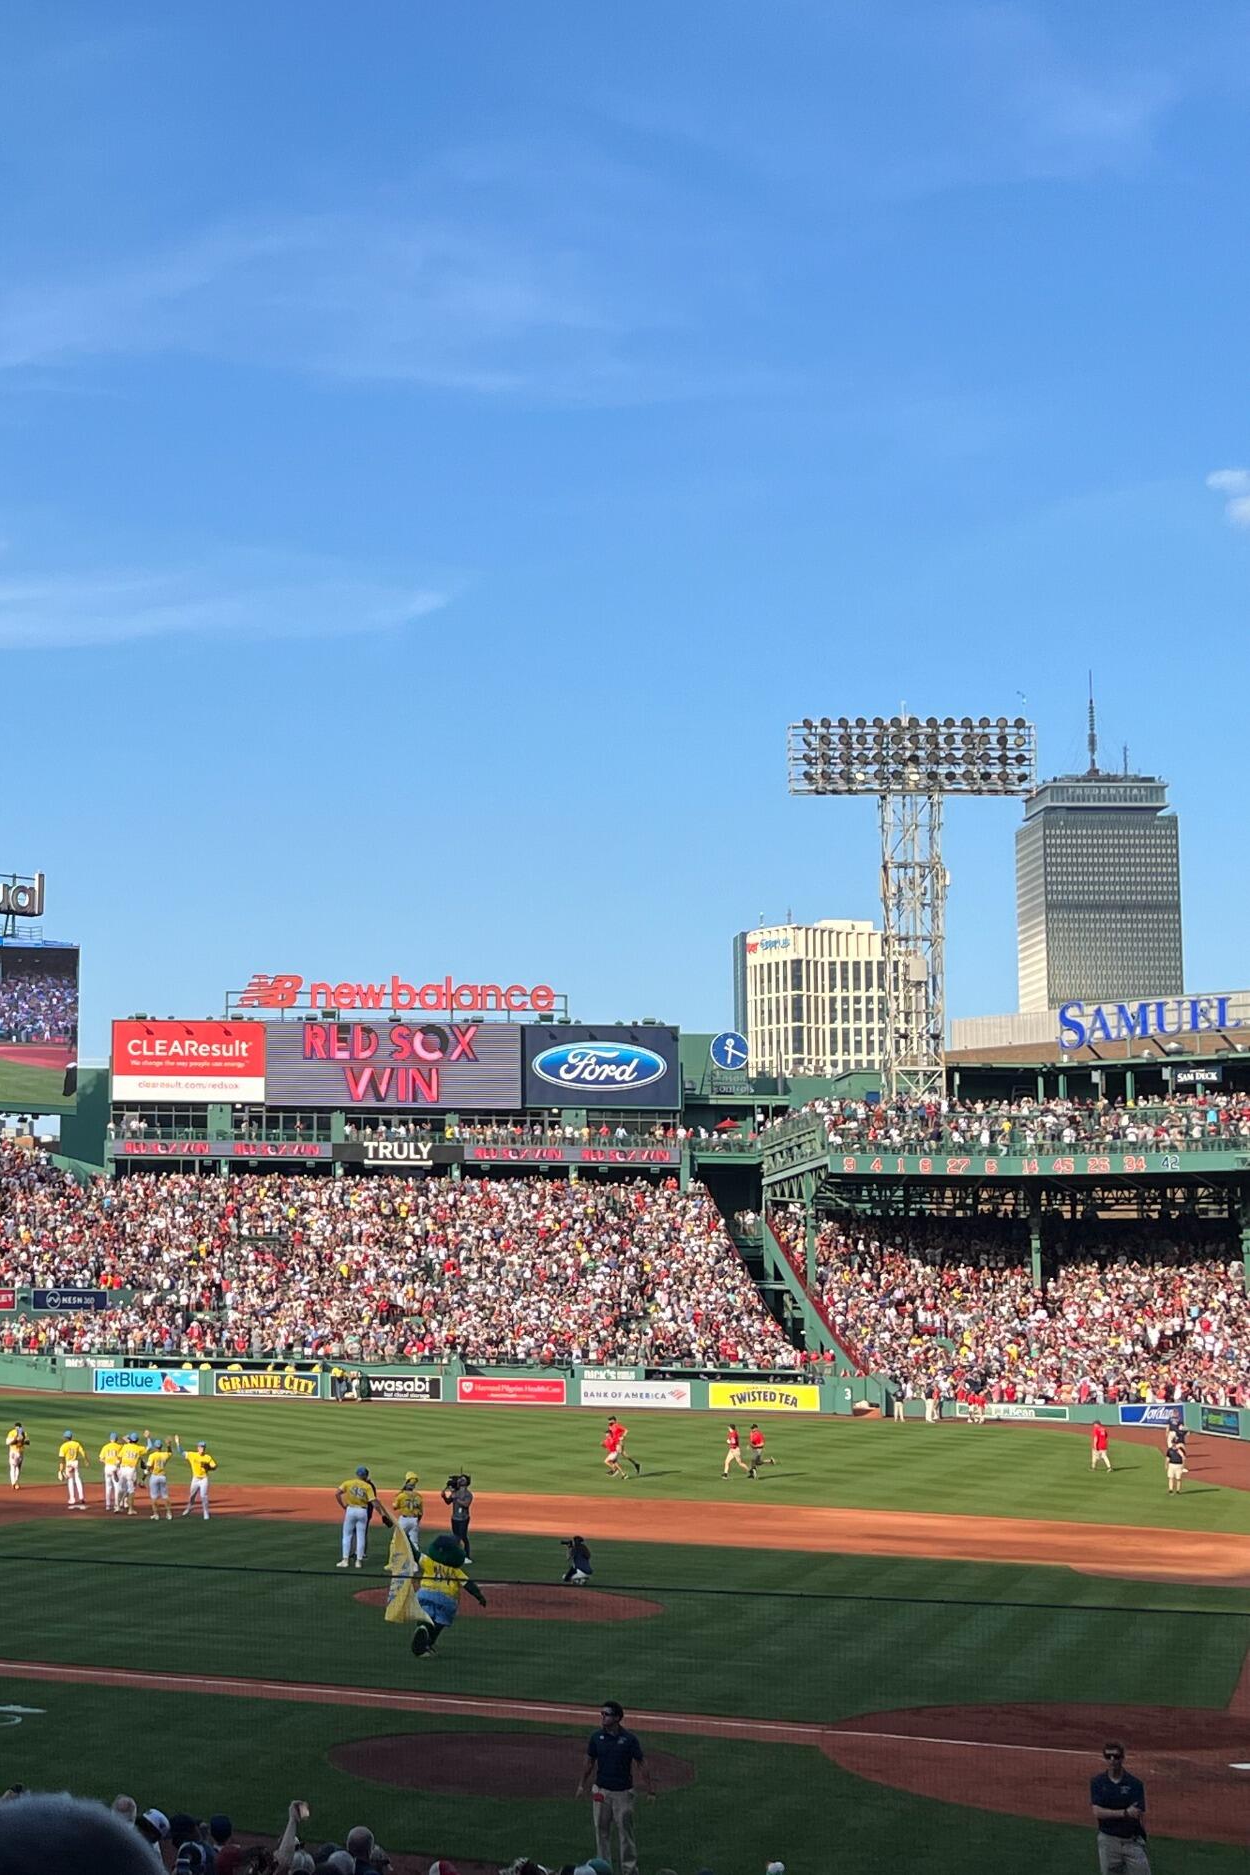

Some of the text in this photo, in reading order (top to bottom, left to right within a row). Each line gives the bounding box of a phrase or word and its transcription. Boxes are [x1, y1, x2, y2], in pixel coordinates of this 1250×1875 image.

[1058, 996, 1242, 1050] SAMUEL
[127, 1040, 250, 1057] CLEAResult
[303, 1023, 480, 1062] RED SOX
[559, 1048, 640, 1081] Ford
[343, 1067, 441, 1103] WIN
[363, 1142, 433, 1160] TRULY
[869, 1157, 883, 1172] 4
[896, 1158, 905, 1173] 1
[946, 1157, 971, 1172] 27
[1022, 1158, 1039, 1174] 14
[1052, 1157, 1075, 1173] 45
[1124, 1156, 1147, 1172] 34
[1160, 1155, 1180, 1170] 42
[62, 1296, 83, 1304] NESN
[100, 1372, 154, 1391] jetBlue
[218, 1374, 317, 1394] GRANITE CITY
[370, 1376, 430, 1392] wasabi
[729, 1391, 799, 1408] TWISTED TEA
